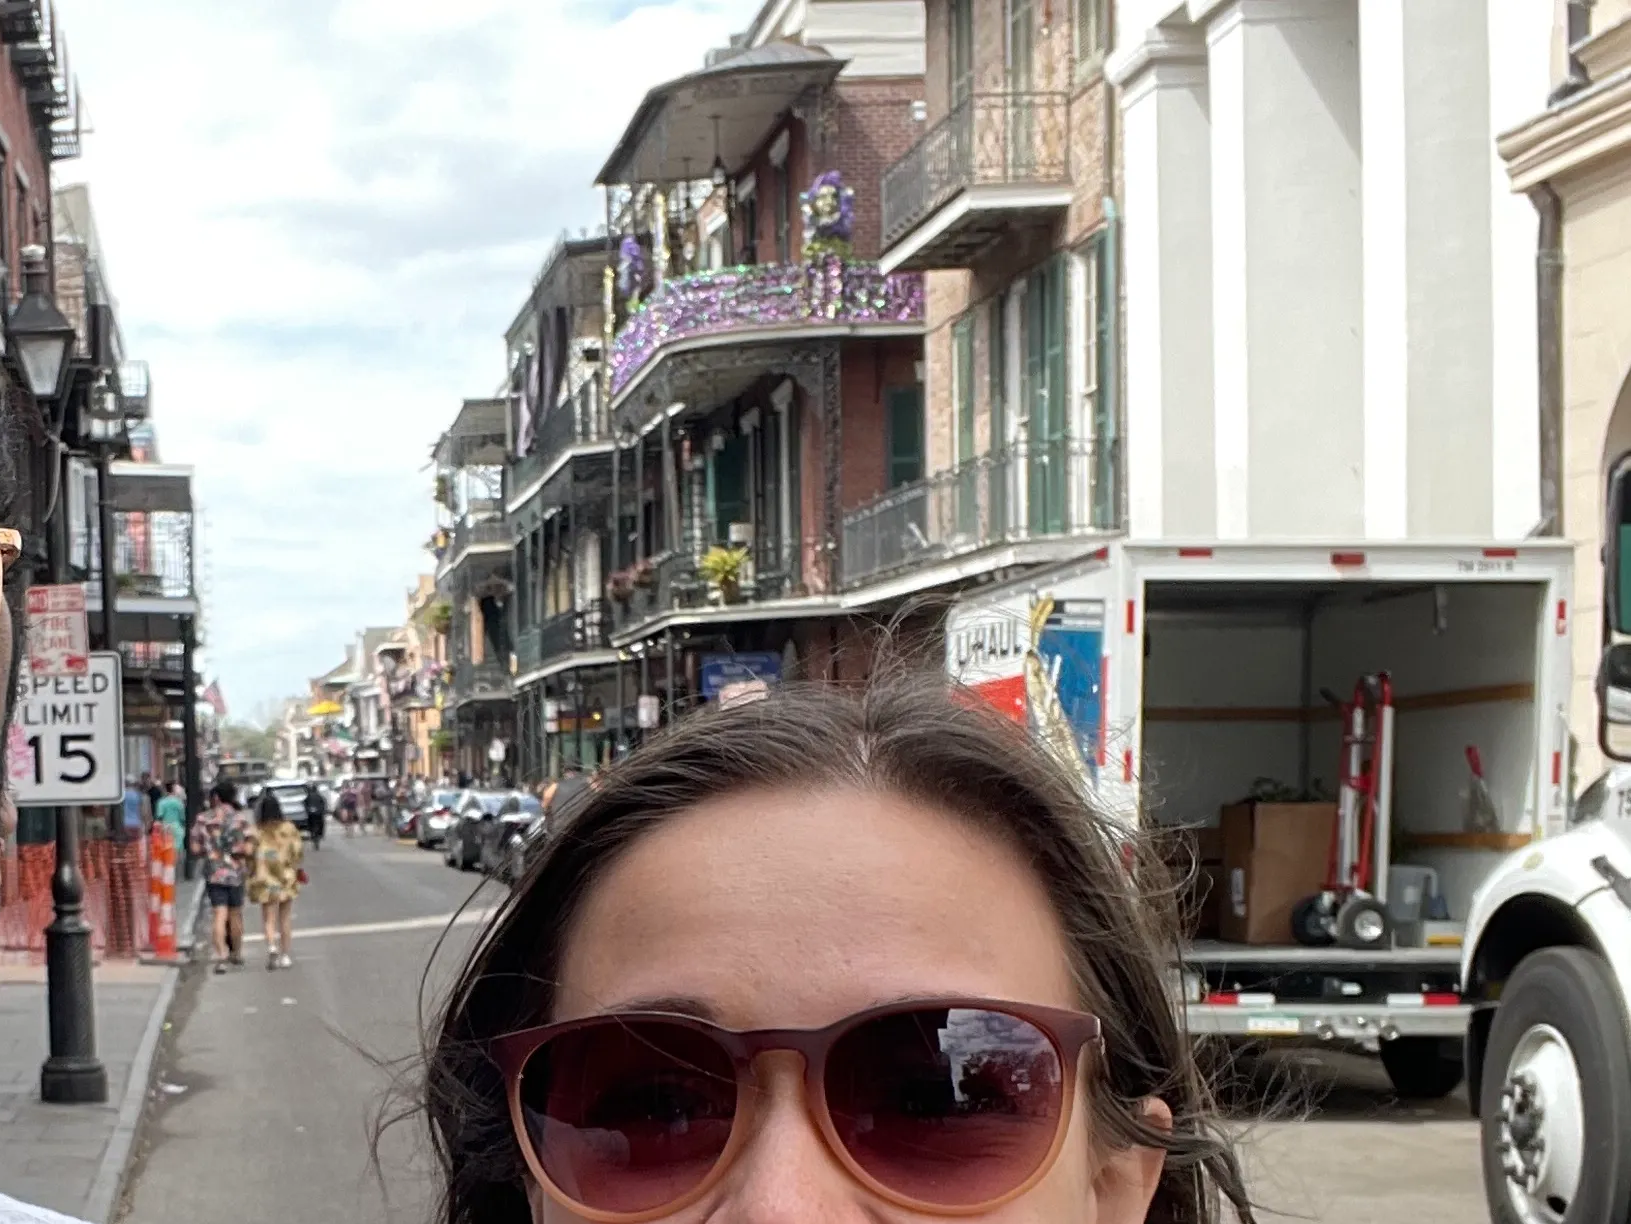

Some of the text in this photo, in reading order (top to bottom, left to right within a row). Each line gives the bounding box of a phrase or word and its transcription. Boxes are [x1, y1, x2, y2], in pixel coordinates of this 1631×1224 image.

[41, 616, 72, 631] FIRE
[17, 672, 109, 696] SPEED
[23, 702, 99, 725] LIMIT
[27, 733, 97, 785] 15
